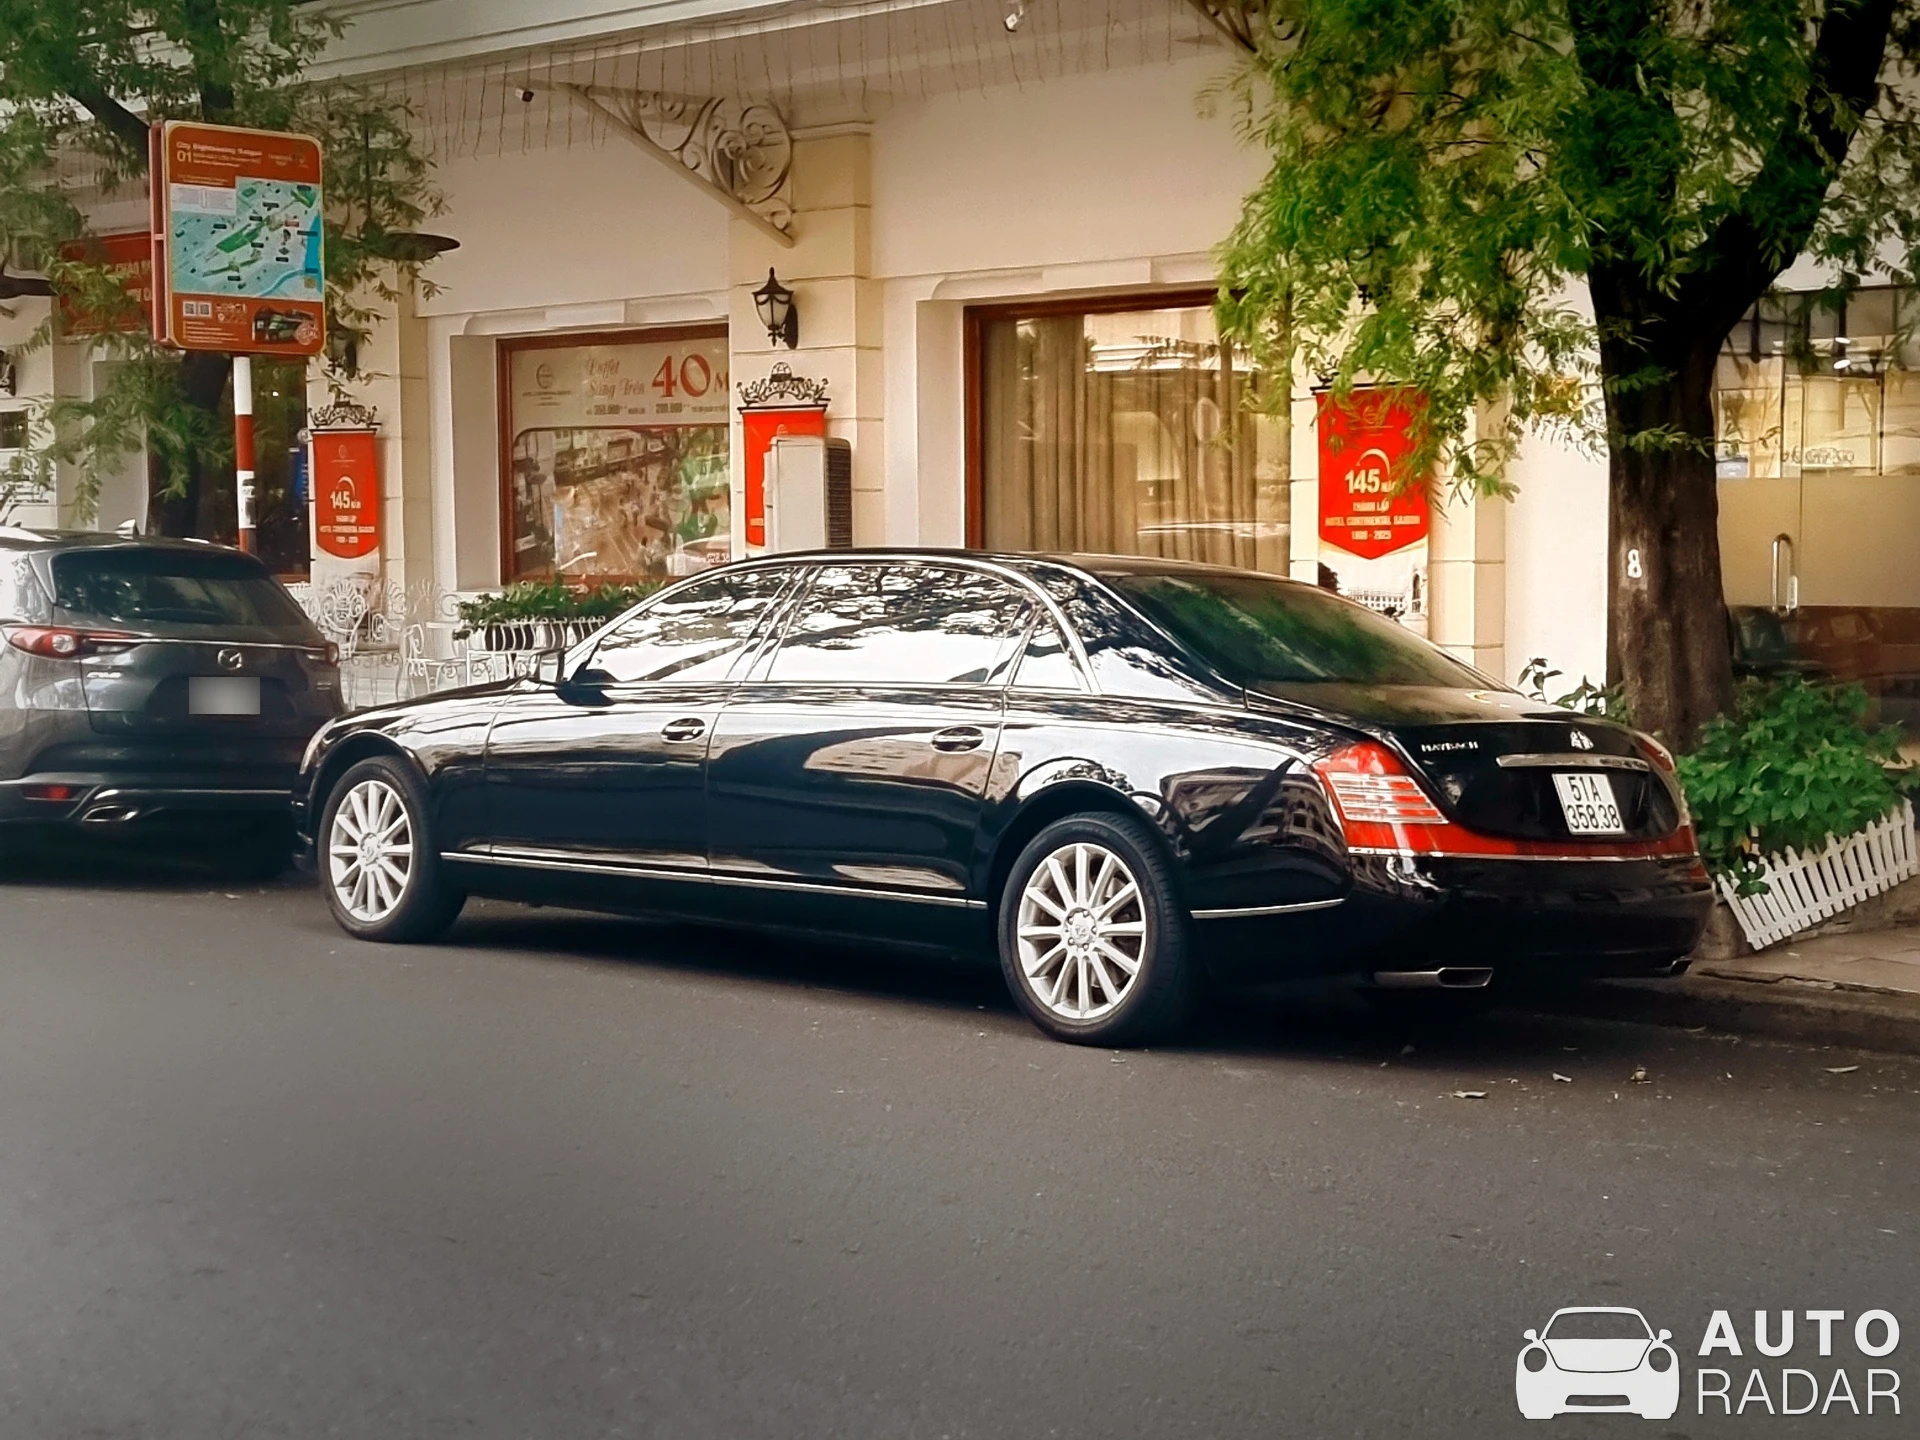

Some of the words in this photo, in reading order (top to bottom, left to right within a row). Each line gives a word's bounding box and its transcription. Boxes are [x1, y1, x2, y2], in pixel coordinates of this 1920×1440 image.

[176, 151, 192, 163] 01
[652, 354, 711, 398] 40
[1344, 468, 1381, 494] 145
[330, 491, 351, 509] 145
[1627, 548, 1643, 579] 8
[1568, 776, 1601, 802] 51A
[1567, 804, 1621, 830] 358.38
